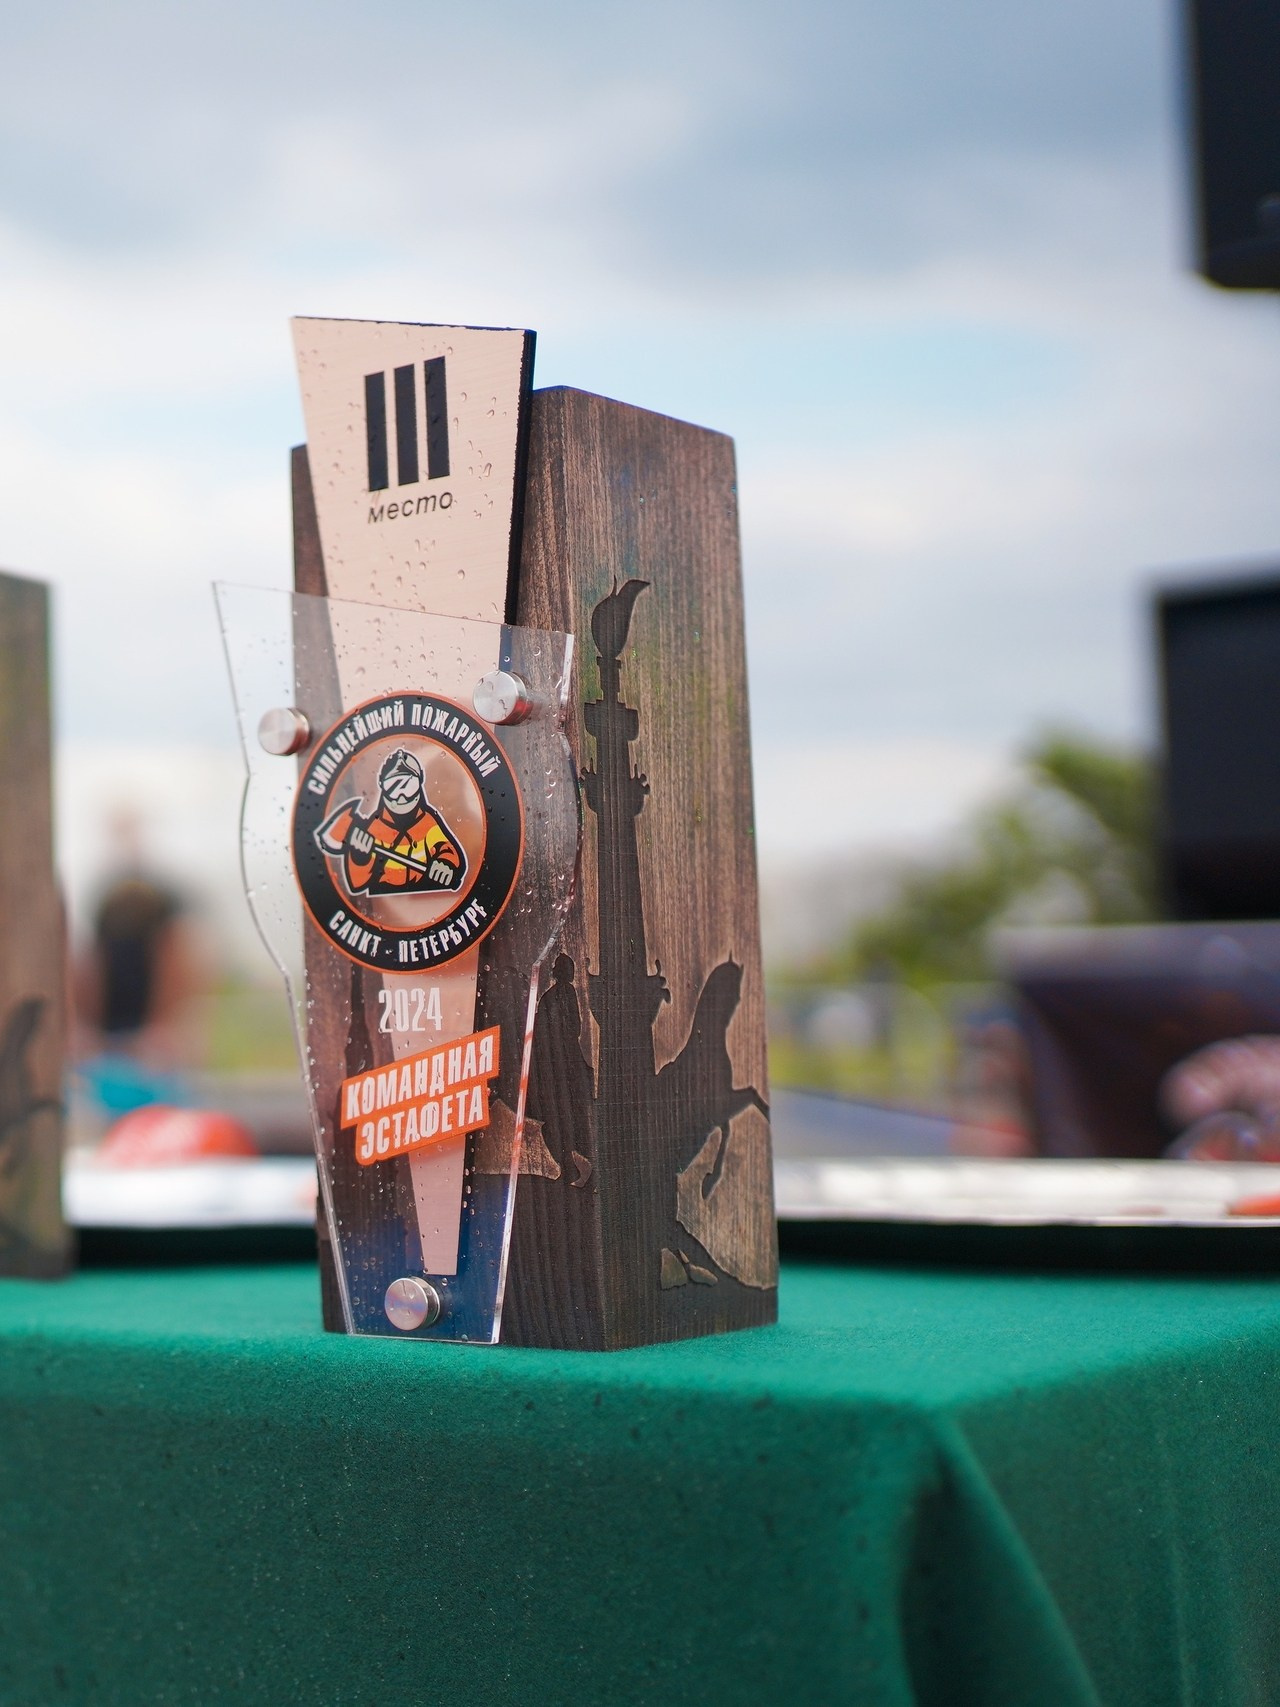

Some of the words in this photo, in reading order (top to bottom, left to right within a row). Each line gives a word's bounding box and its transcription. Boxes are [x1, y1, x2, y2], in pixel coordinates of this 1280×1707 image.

[364, 356, 450, 492] III
[308, 701, 405, 795] СИЛЬНЕЙШИЙ
[411, 703, 502, 778] ПОЖАРНЫЙ
[329, 909, 382, 957] САНКТ
[398, 898, 487, 963] ПЕТЕРБУРГ
[378, 987, 443, 1034] 2024
[346, 1035, 494, 1120] КОМАНДНАЯ
[361, 1085, 483, 1160] ЭСТАФЕТА
